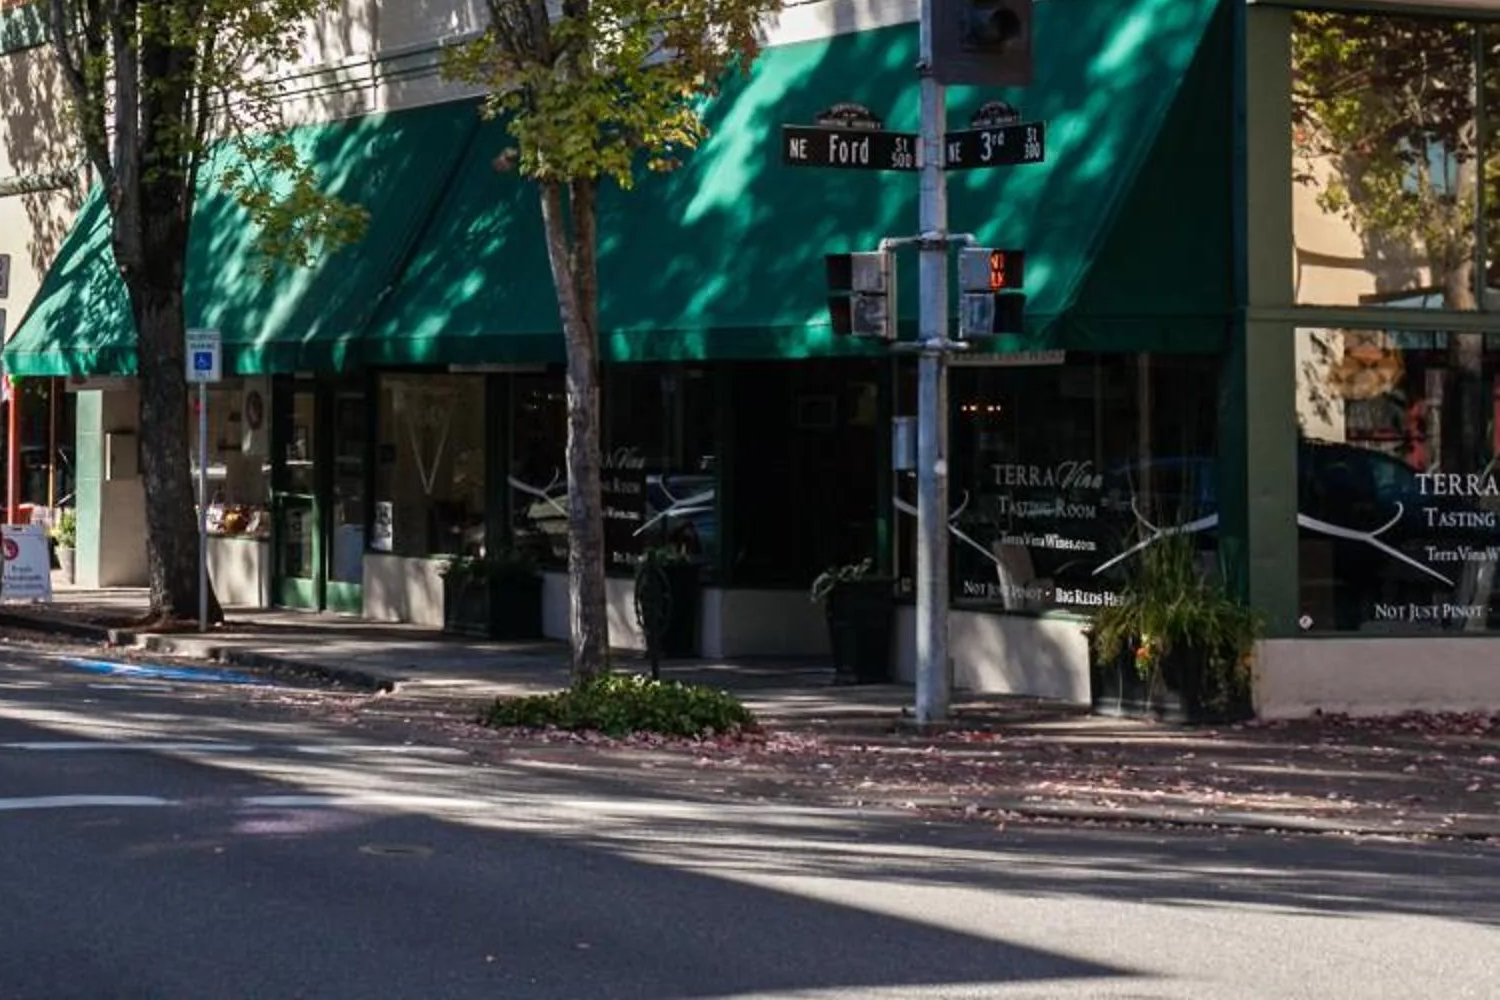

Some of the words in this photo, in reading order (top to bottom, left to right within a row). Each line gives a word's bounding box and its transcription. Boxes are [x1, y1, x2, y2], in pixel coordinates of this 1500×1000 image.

[789, 138, 808, 159] NE
[829, 134, 869, 164] Ford
[948, 142, 962, 162] NE
[980, 131, 1005, 161] 3rd
[991, 464, 1054, 487] TERRA
[1415, 473, 1500, 496] TERRA
[1055, 498, 1096, 518] ROOM
[1423, 507, 1496, 528] TASTING
[963, 580, 985, 596] NOT
[1055, 587, 1074, 603] BIG
[1075, 589, 1102, 606] REDS
[1374, 604, 1406, 618] NOT
[1408, 603, 1439, 623] JUST
[1443, 604, 1483, 618] PINOT
